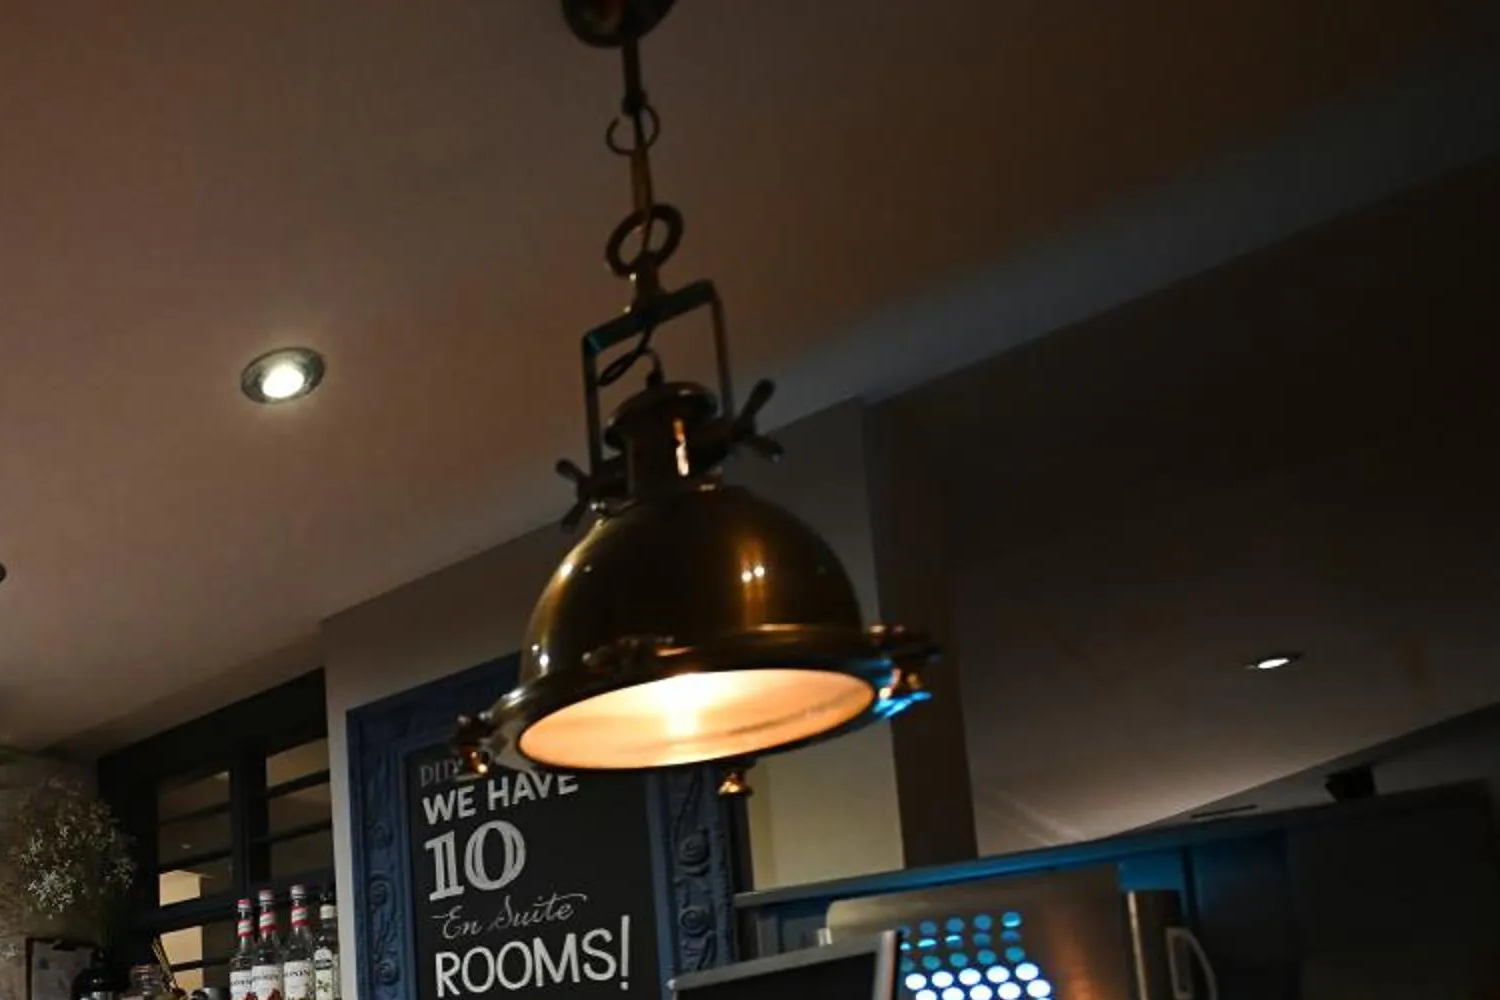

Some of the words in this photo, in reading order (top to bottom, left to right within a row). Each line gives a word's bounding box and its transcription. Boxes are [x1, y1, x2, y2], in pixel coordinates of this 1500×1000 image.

[422, 785, 477, 825] WE
[487, 773, 579, 811] HAVE
[424, 820, 526, 901] 10
[432, 905, 483, 940] En
[489, 893, 588, 931] Suite
[435, 914, 630, 998] ROOMS!
